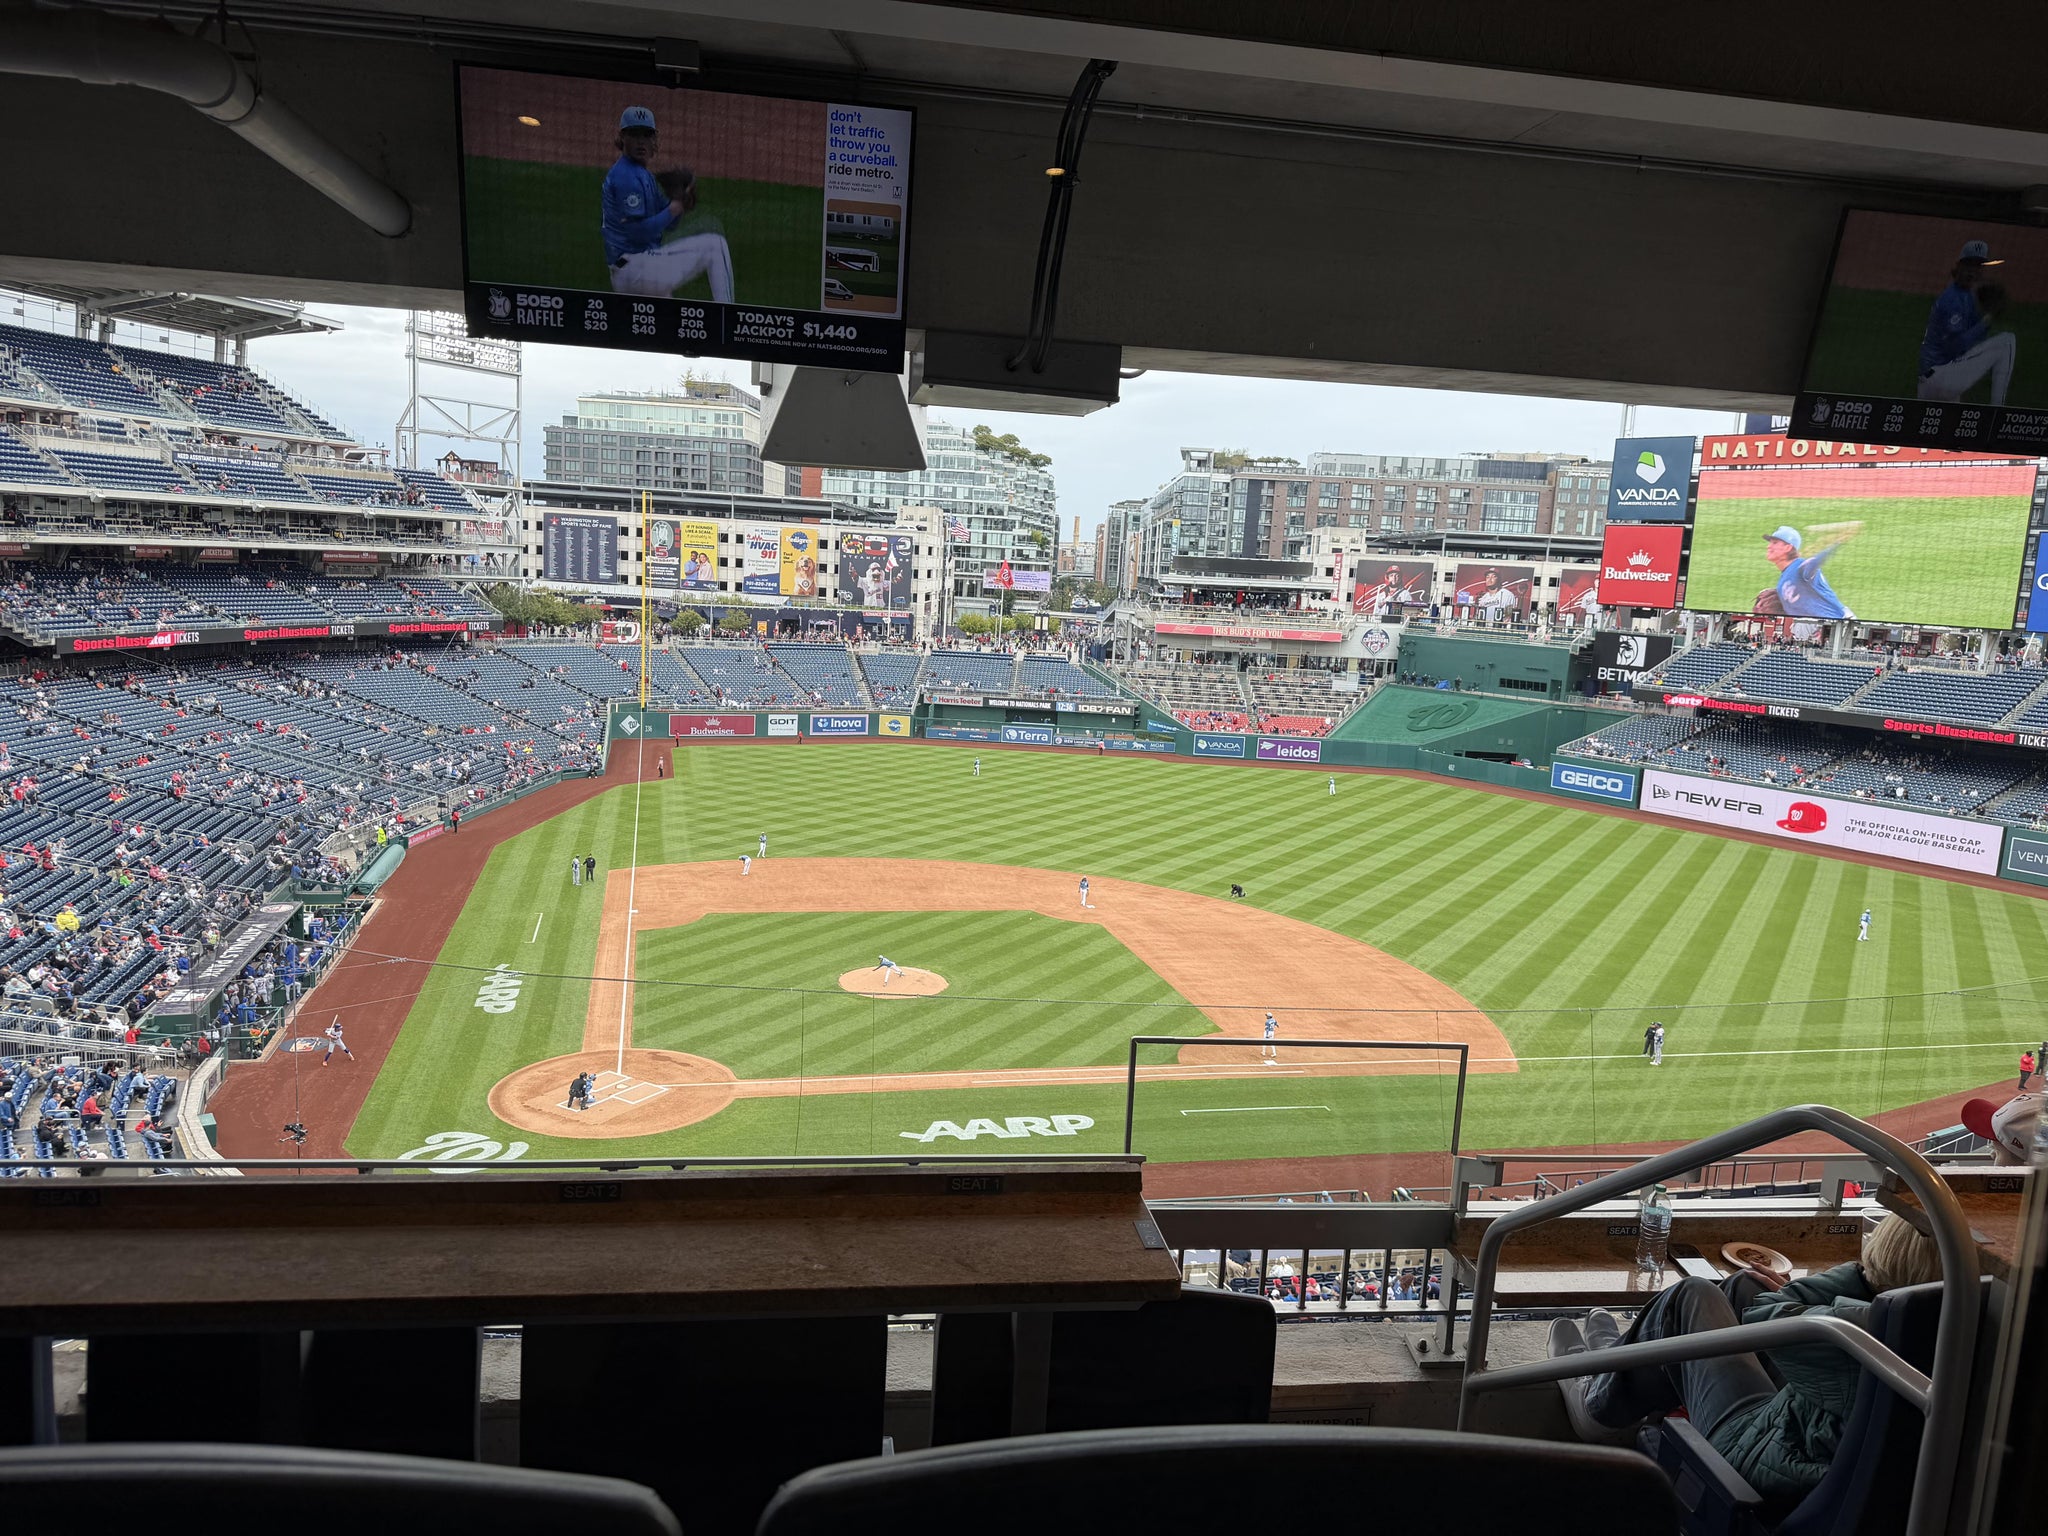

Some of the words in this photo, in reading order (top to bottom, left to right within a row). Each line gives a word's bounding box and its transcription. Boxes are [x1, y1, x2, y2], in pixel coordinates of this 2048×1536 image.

[830, 110, 862, 123] don't
[830, 123, 845, 136] let
[848, 125, 885, 139] traffic
[830, 137, 865, 150] throw
[868, 143, 890, 154] you
[829, 152, 836, 161] a
[840, 152, 898, 167] curveball.
[829, 163, 852, 175] ride
[855, 167, 894, 180] metro.
[516, 294, 564, 308] 5050
[588, 299, 603, 310] 20
[633, 303, 654, 314] 100
[680, 307, 704, 318] 500
[517, 308, 564, 327] RAFFLE
[584, 311, 607, 321] FOR
[633, 315, 655, 325] FOR
[737, 312, 795, 327] TODAY'S
[584, 320, 608, 331] $20
[632, 324, 656, 335] $40
[681, 319, 704, 329] FOR
[678, 328, 707, 339] $100
[733, 324, 795, 339] JACKPOT
[803, 322, 857, 340] $1,440
[747, 337, 769, 345] TICKETS
[1835, 401, 1872, 414] 5050
[1890, 404, 1903, 414] 20
[1925, 407, 1943, 417] 100
[1885, 414, 1904, 423] FOR
[1962, 410, 1981, 420] 500
[1831, 413, 1871, 430] RAFFLE
[1922, 417, 1940, 426] FOR
[1959, 420, 1978, 429] FOR
[1882, 423, 1902, 433] $20
[1919, 425, 1938, 435] $40
[1954, 428, 1978, 438] $100
[1999, 423, 2046, 435] JACKPOT
[1711, 439, 1901, 459] NATIONALS
[1616, 488, 1680, 500] VANDA
[750, 541, 778, 550] HVAC
[761, 550, 777, 559] 911
[1604, 567, 1672, 582] Budweiser
[244, 628, 278, 640] Sports
[279, 625, 329, 638] Illustrated
[331, 625, 355, 635] TICKETS
[388, 623, 420, 634] Sports
[421, 622, 467, 632] Illustrated
[468, 621, 489, 631] TICKETS
[1212, 627, 1228, 635] THIS
[1230, 628, 1250, 636] BUD'S
[1252, 629, 1265, 637] FOR
[1266, 629, 1283, 637] YOU.
[74, 638, 114, 651] Sports
[116, 633, 171, 648] Illustrated
[174, 632, 200, 644] TICKETS
[1598, 667, 1649, 683] BETMG
[939, 696, 959, 704] Harris
[960, 697, 981, 705] Teeter
[1663, 694, 1702, 708] Sports
[1703, 697, 1766, 714] Illustrated
[1768, 705, 1800, 718] TICKETS
[1058, 702, 1074, 711] 12:36
[1106, 706, 1130, 714] FAN
[831, 718, 862, 728] Inova
[690, 727, 733, 735] Budweiser
[1019, 730, 1048, 741] Terra
[1884, 719, 1934, 734] Sports
[1935, 723, 2015, 744] Illustrated
[1207, 741, 1240, 749] VANDA
[1277, 744, 1318, 758] leidos
[1560, 770, 1623, 793] GEICO
[1844, 825, 1857, 833] OF
[1858, 828, 1891, 839] MAJOR
[1893, 834, 1930, 846] LEAGUE
[1850, 819, 1867, 828] THE
[1869, 822, 1910, 836] OFFICIAL
[1912, 829, 1958, 843] ON-FIELD
[1959, 836, 1981, 847] CAP
[899, 1114, 1095, 1142] AARP
[952, 1178, 987, 1191] SEAT
[1990, 1178, 2023, 1189] SEAT
[38, 1190, 80, 1204] SEAT
[563, 1185, 605, 1199] SEAT
[609, 1185, 618, 1197] 2
[1609, 1227, 1630, 1235] SEAT
[1829, 1225, 1850, 1233] SEAT
